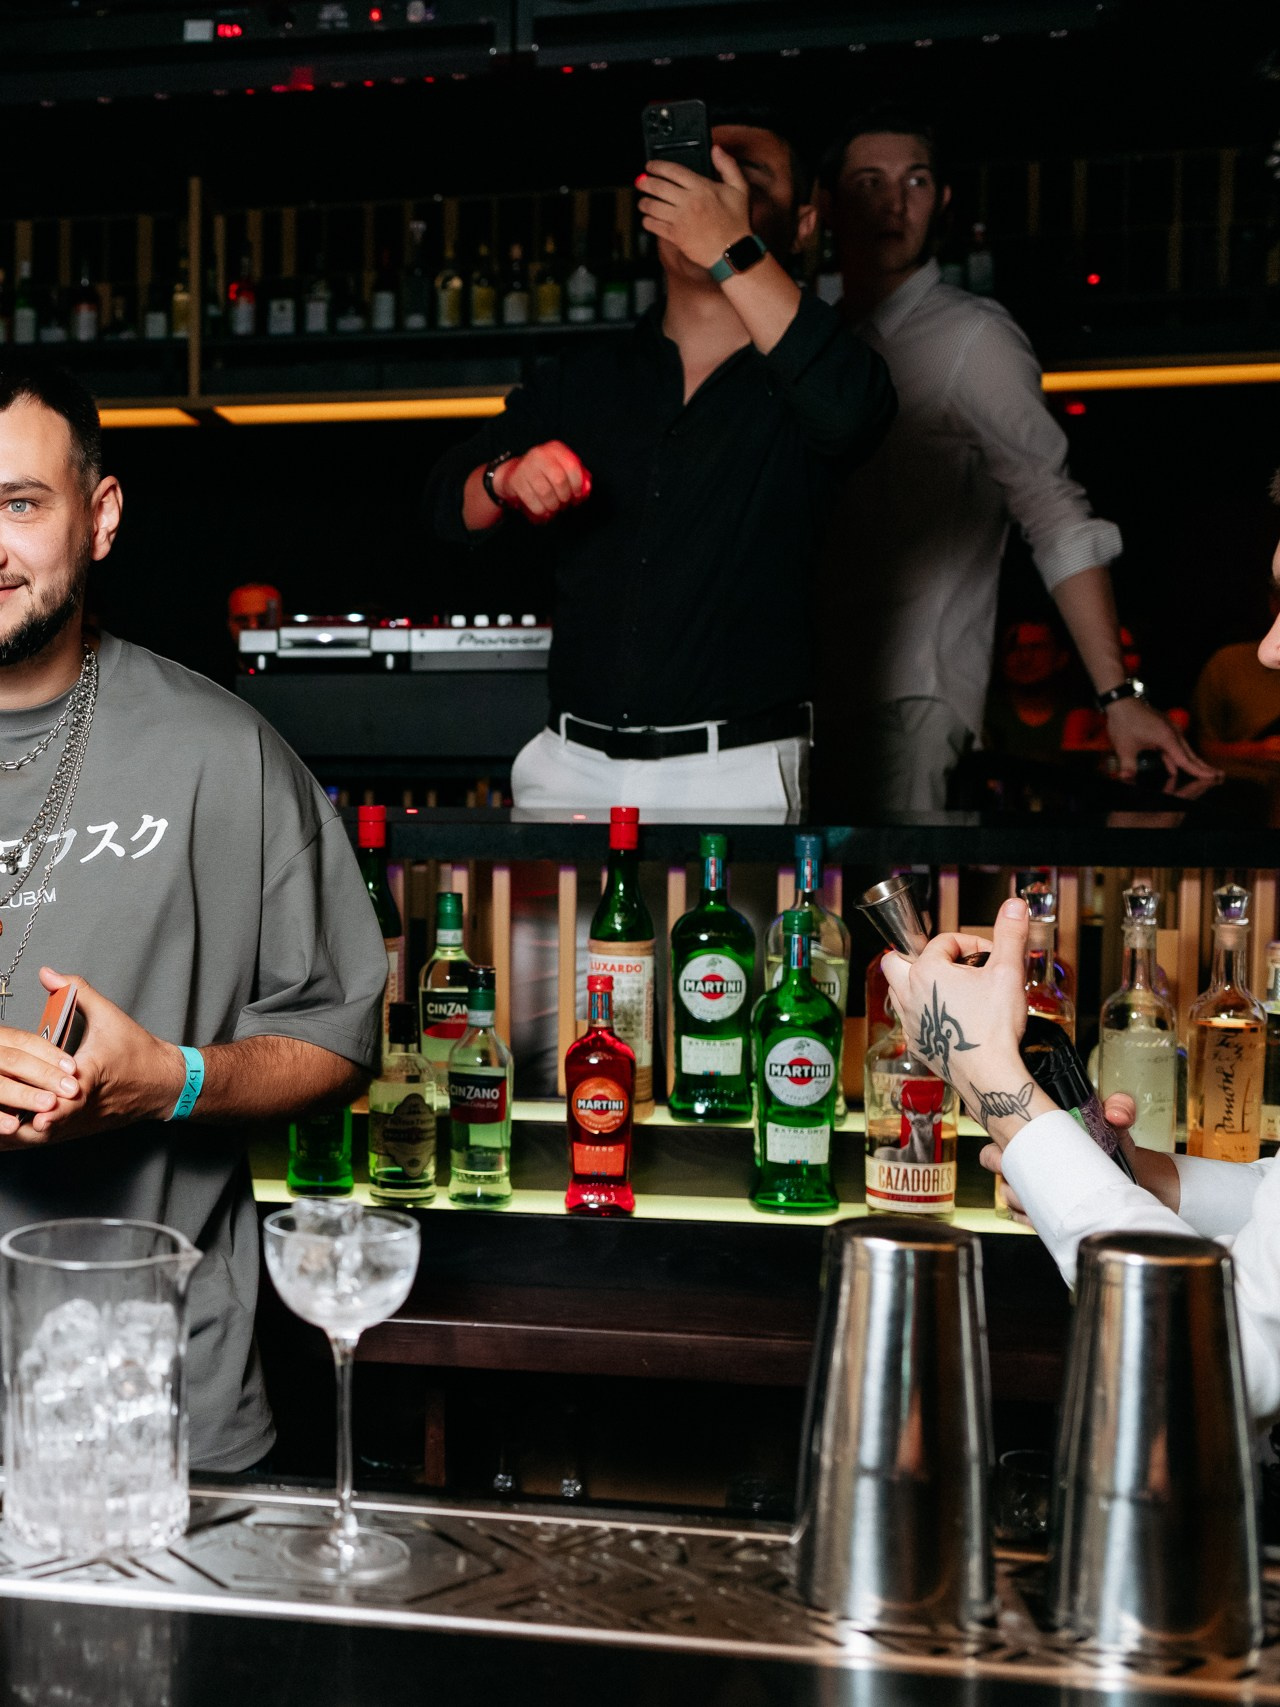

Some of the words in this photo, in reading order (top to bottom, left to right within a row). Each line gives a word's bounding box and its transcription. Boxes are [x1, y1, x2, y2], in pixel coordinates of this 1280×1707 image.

[589, 961, 643, 974] LUXARDO
[684, 979, 742, 993] MARTINI
[426, 1001, 469, 1017] CINZAN
[770, 1063, 830, 1078] MARTINI
[450, 1084, 500, 1100] CINZANO
[577, 1099, 624, 1110] MARTINI
[878, 1165, 952, 1193] CAZADORES
